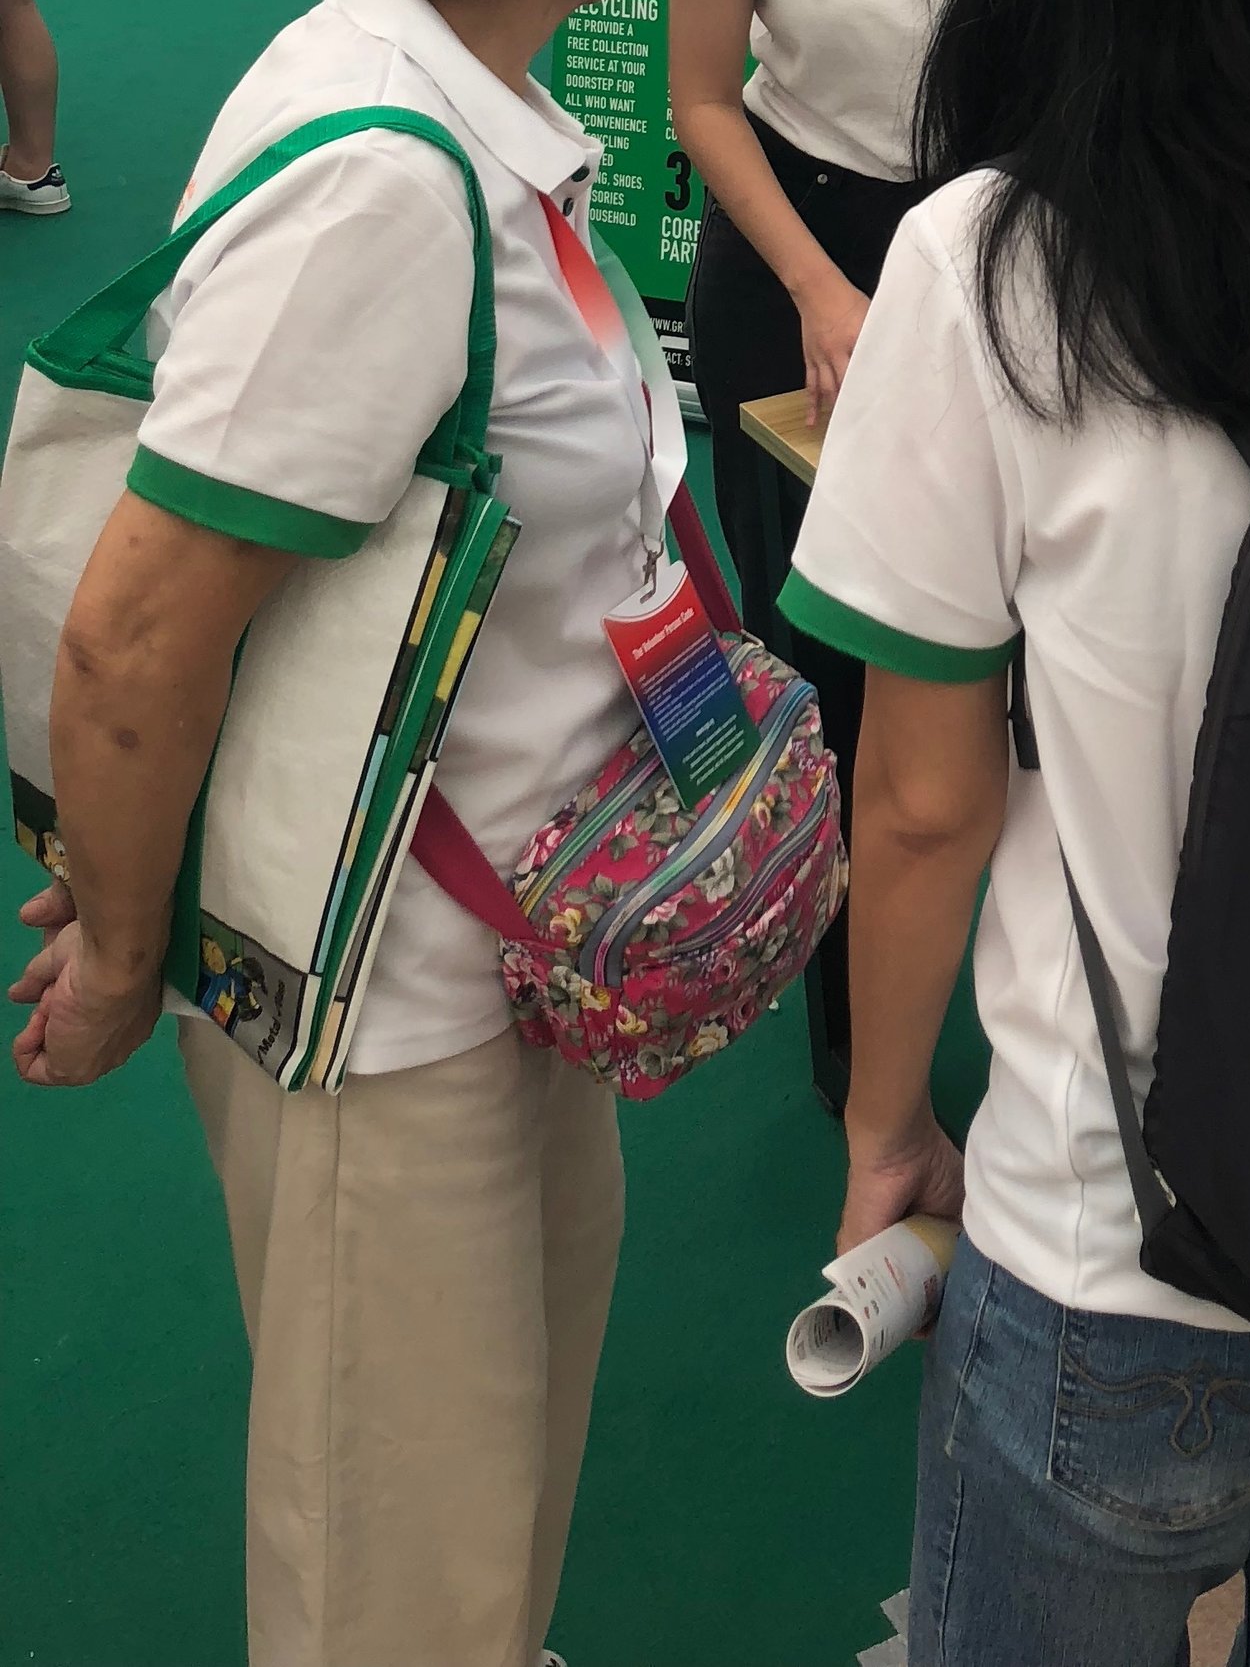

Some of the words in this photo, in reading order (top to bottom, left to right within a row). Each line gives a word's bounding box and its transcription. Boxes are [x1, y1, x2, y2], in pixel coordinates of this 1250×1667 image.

[568, 17, 582, 31] WE
[584, 20, 624, 36] PROVIDE
[627, 23, 634, 36] A
[567, 36, 590, 51] FREE
[592, 39, 649, 57] COLLECTION
[566, 55, 606, 72] SERVICE
[607, 59, 619, 73] AT
[621, 61, 646, 76] YOUR
[566, 74, 614, 91] DOORSTEP
[616, 79, 635, 94] FOR
[565, 93, 582, 107] ALL
[585, 95, 607, 110] WHO
[609, 97, 636, 113] WANT
[584, 114, 648, 133] CONVENIENCE
[664, 151, 692, 211] 3
